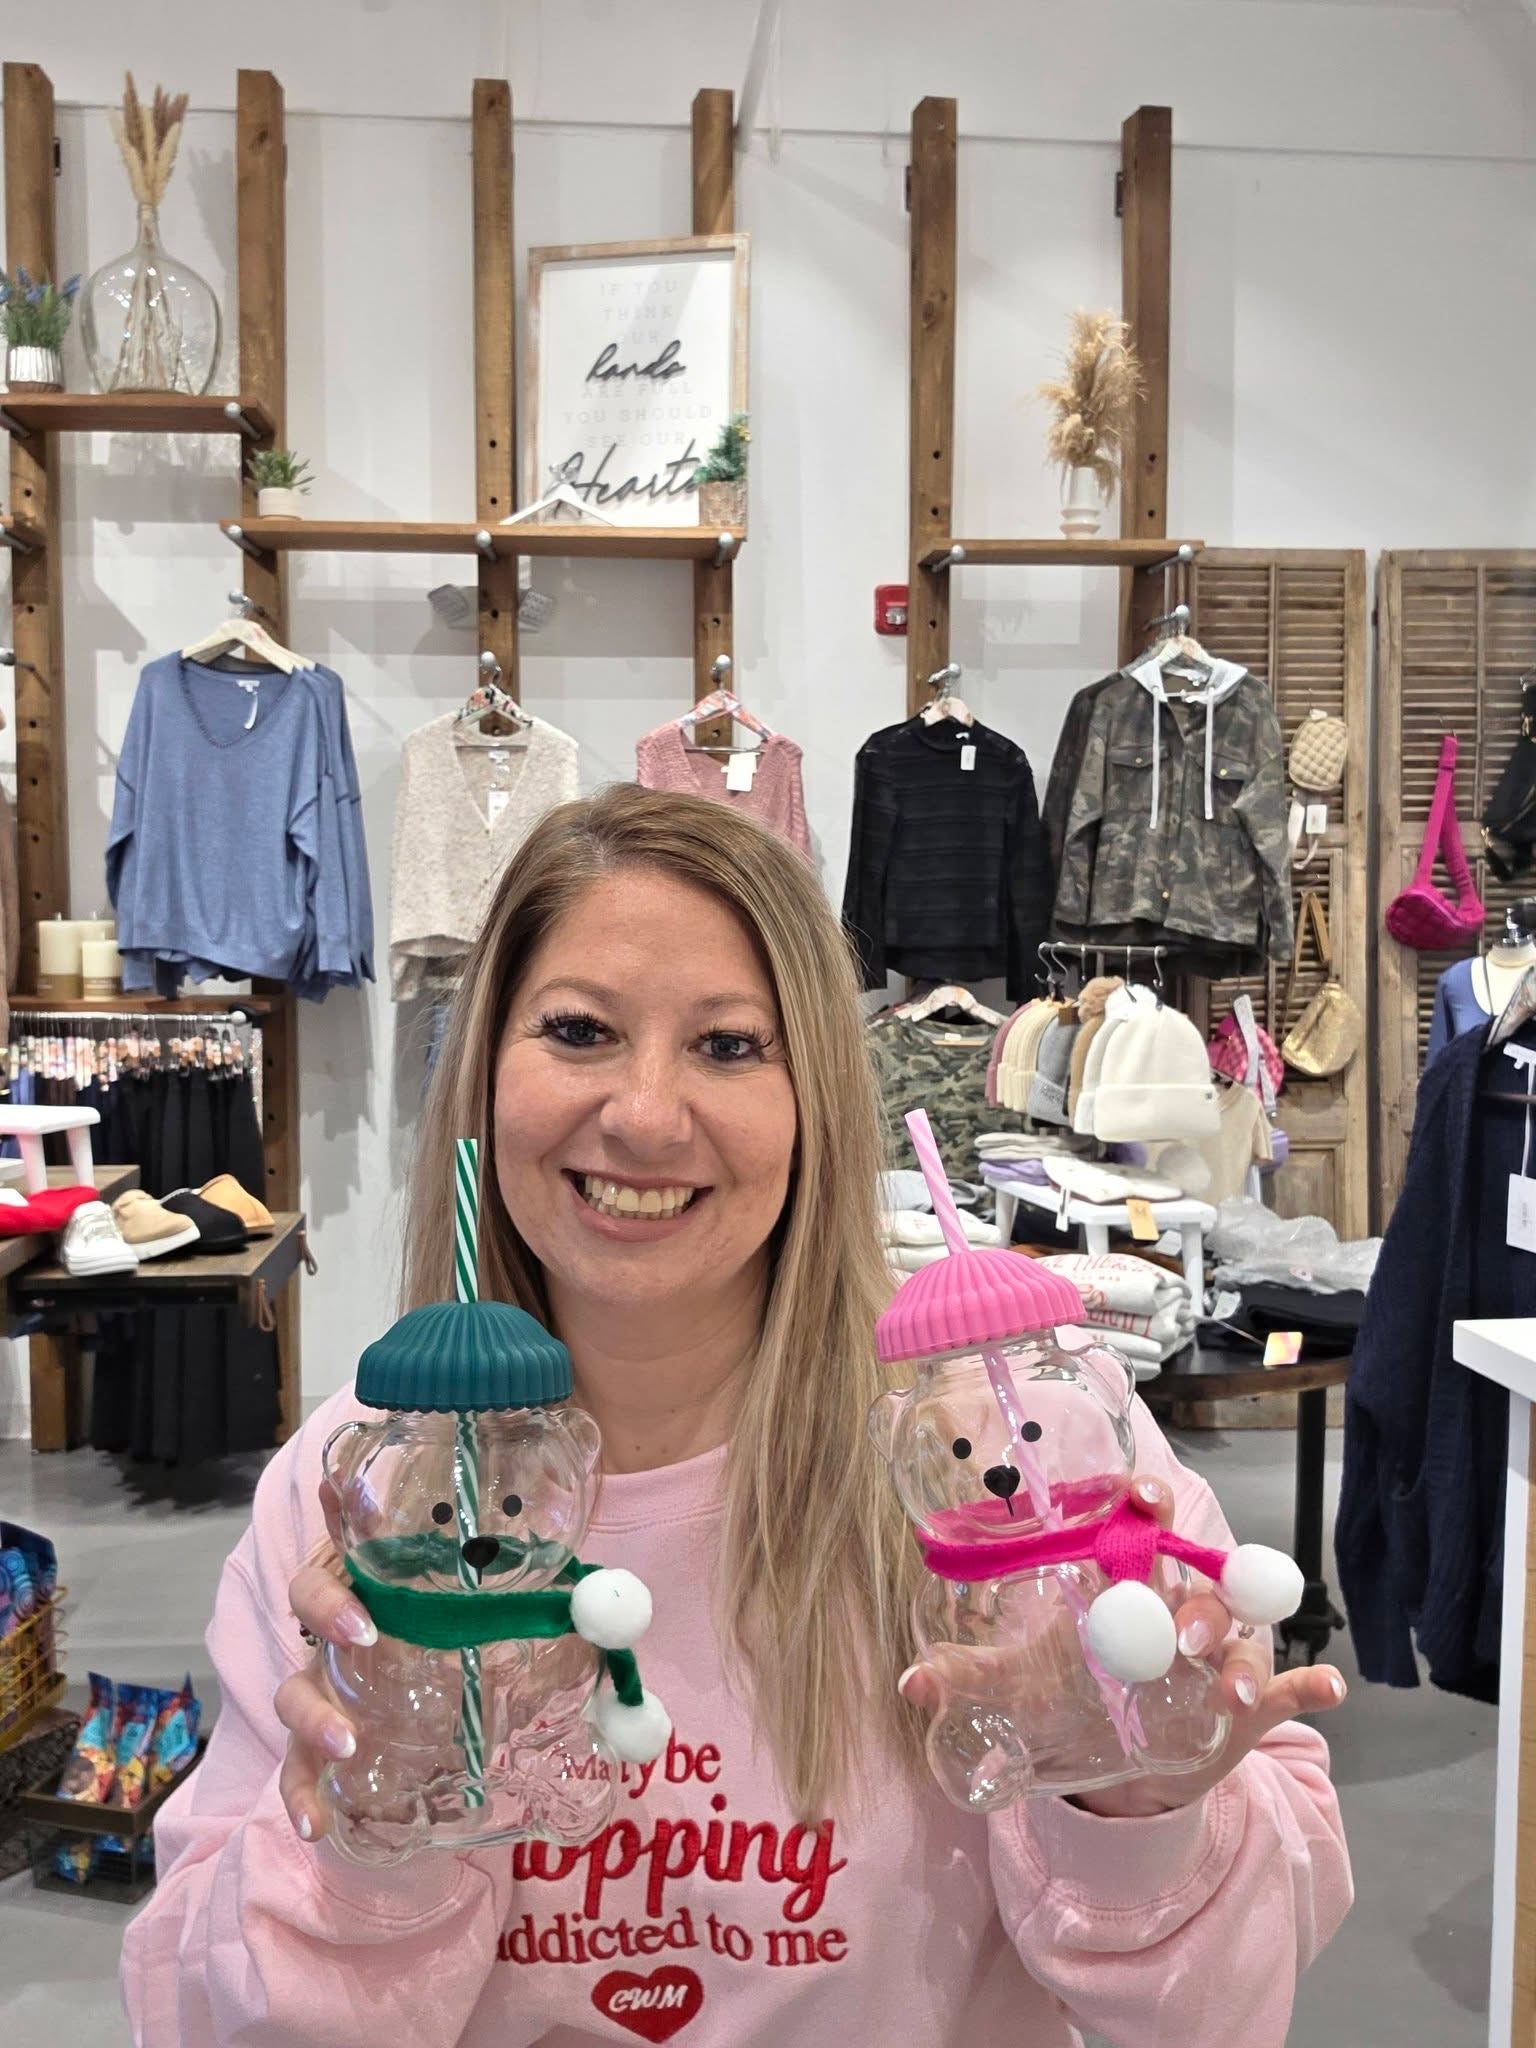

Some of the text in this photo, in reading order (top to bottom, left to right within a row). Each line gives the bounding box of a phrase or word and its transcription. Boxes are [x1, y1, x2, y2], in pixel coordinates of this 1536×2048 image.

[634, 280, 678, 295] YOU
[602, 306, 674, 322] THINK
[563, 405, 713, 425] YOU SHOULD
[636, 431, 686, 447] OUR
[706, 1912, 753, 1962] to
[763, 1927, 849, 1966] me
